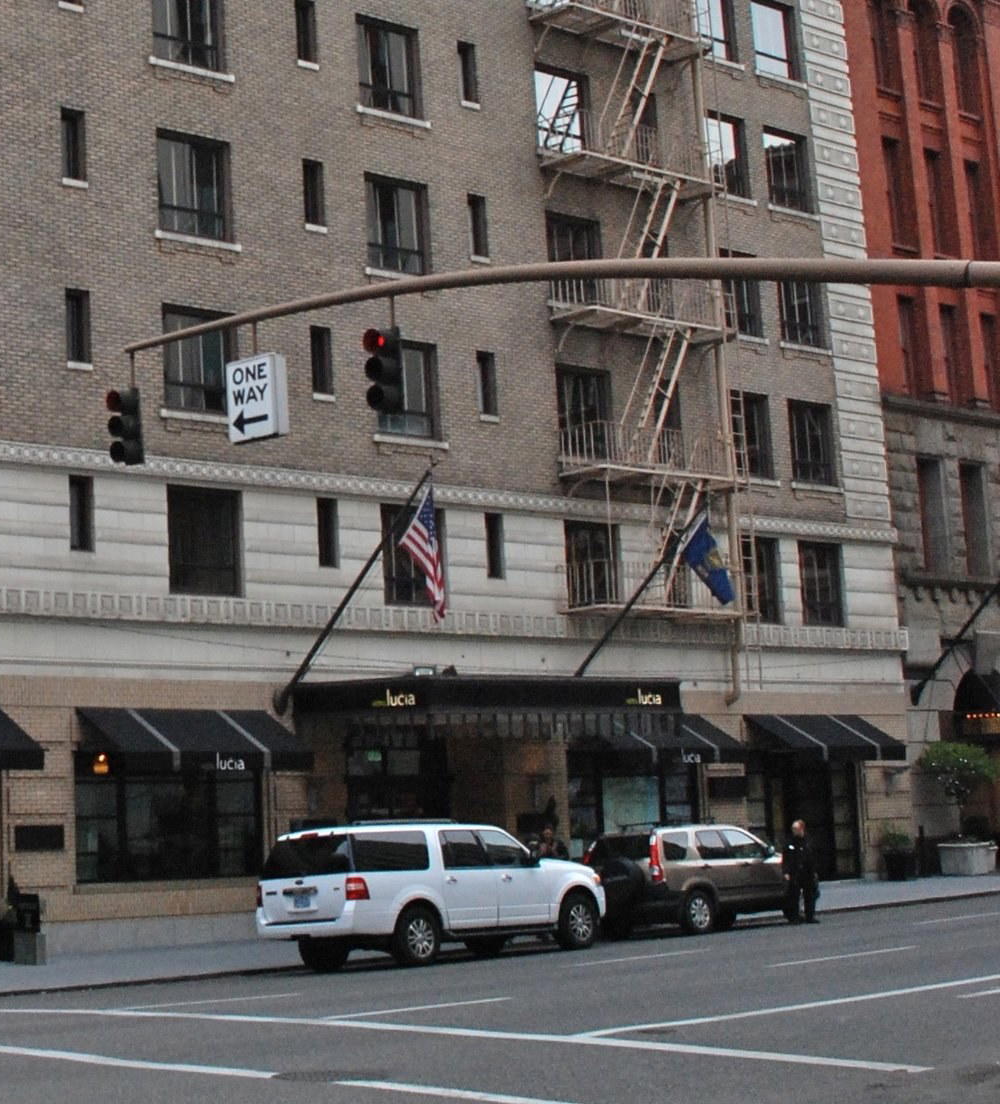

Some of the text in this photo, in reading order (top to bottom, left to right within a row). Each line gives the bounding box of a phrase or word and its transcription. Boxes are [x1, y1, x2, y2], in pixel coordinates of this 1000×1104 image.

[232, 362, 268, 386] ONE
[232, 382, 268, 407] WAY
[386, 688, 416, 707] lucia
[216, 751, 246, 771] lucia
